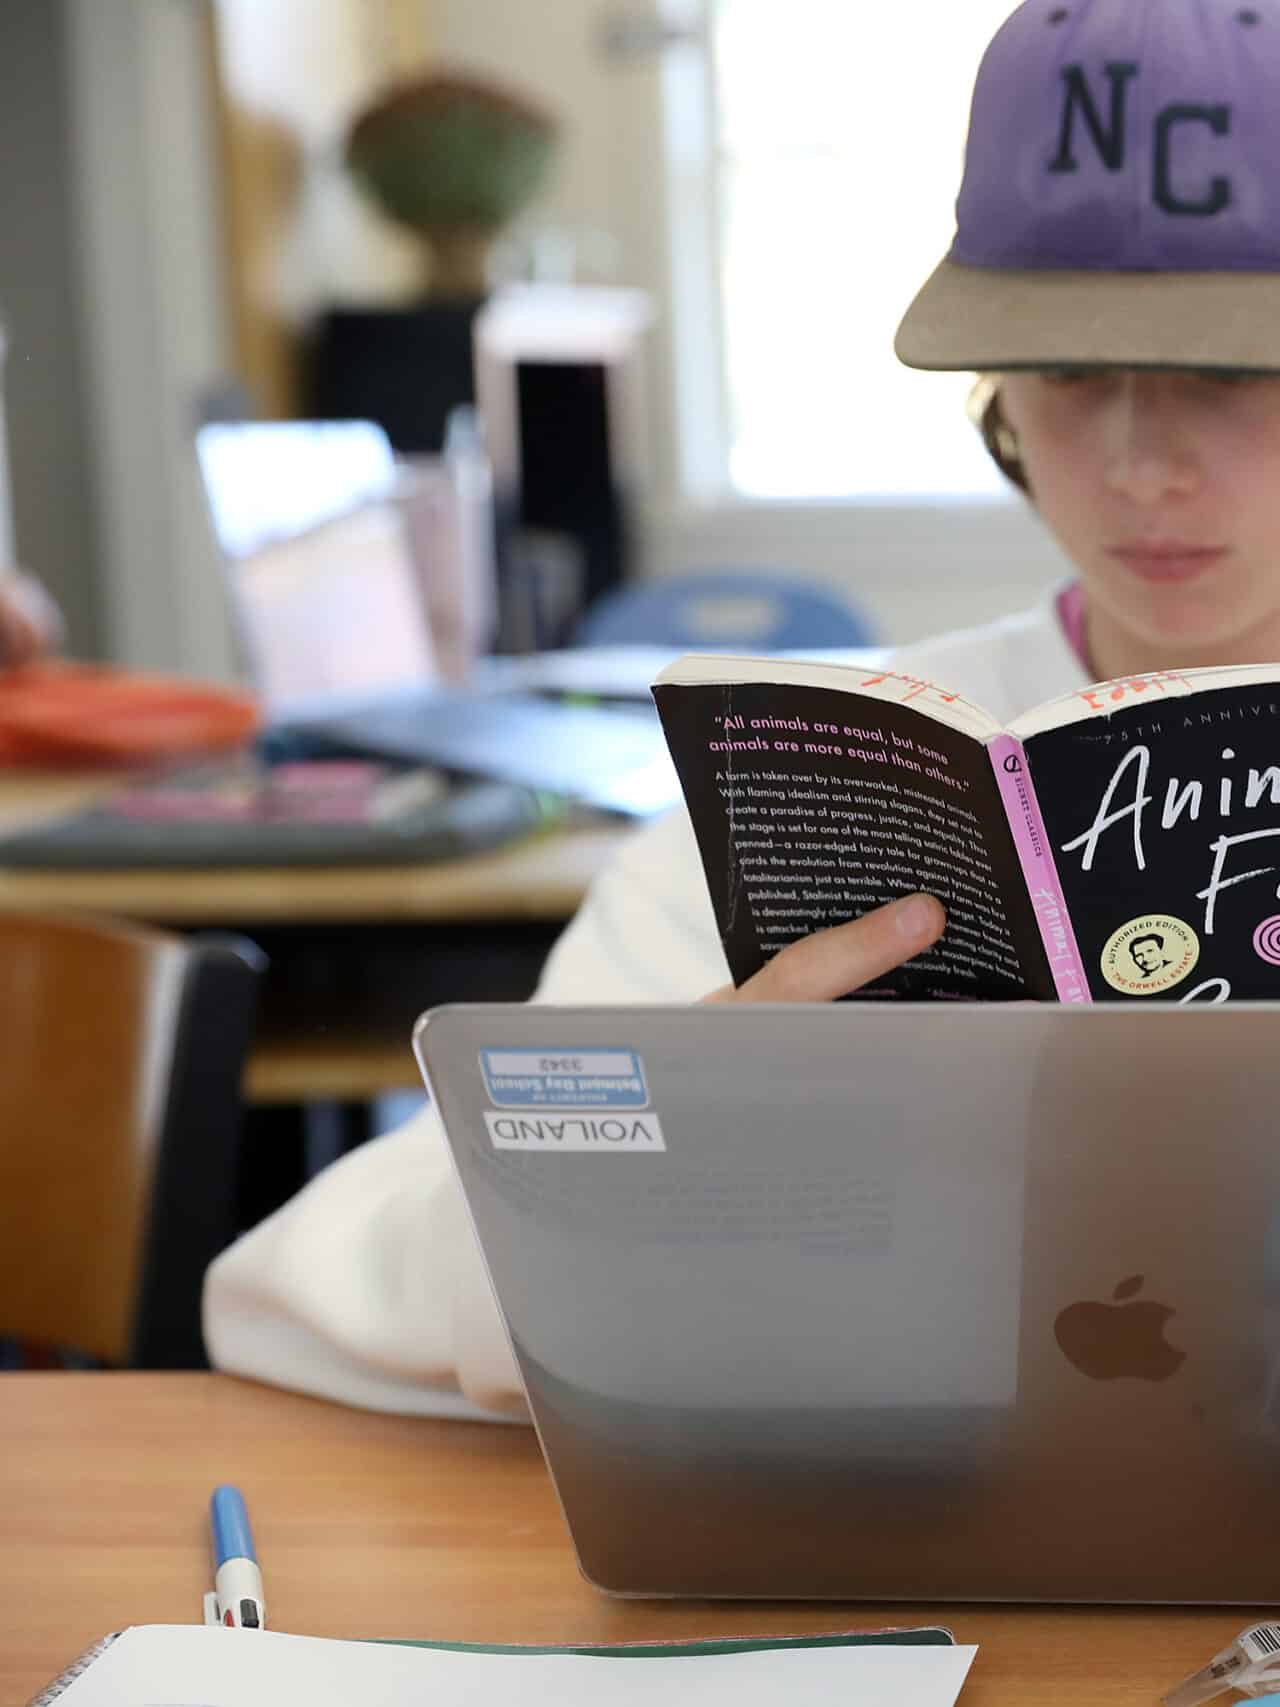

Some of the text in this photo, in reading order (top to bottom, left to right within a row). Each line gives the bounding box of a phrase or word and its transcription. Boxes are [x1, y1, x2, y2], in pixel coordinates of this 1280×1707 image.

[750, 715, 809, 731] animals
[814, 722, 839, 734] are
[843, 726, 888, 745] equal,
[891, 731, 913, 750] but
[917, 745, 949, 765] some
[1104, 722, 1161, 744] 75TH
[709, 736, 769, 752] animals
[774, 740, 800, 752] are
[804, 742, 843, 755] more
[847, 747, 888, 763] equal
[891, 752, 922, 773] than
[716, 771, 724, 780] A
[726, 770, 750, 781] farm
[752, 771, 760, 781] is
[762, 771, 790, 781] taken
[815, 772, 828, 786] by
[830, 776, 841, 785] its
[903, 788, 946, 808] mistreated
[719, 787, 745, 798] With
[747, 786, 786, 800] flaming
[788, 789, 830, 800] idealism
[832, 792, 851, 802] and
[854, 796, 888, 808] stirring
[928, 810, 945, 824] they
[974, 830, 982, 839] to
[726, 806, 758, 814] create
[770, 806, 814, 816] paradise
[818, 807, 828, 816] of
[831, 810, 876, 822] progress,
[914, 822, 931, 832] and
[970, 840, 988, 856] Thus
[748, 823, 775, 834] stage
[778, 824, 786, 832] is
[788, 824, 802, 832] set
[804, 822, 817, 833] for
[820, 826, 838, 834] one
[841, 825, 850, 836] of
[853, 826, 868, 836] the
[870, 830, 892, 840] most
[894, 832, 922, 847] telling
[740, 856, 768, 866] cords
[770, 856, 786, 866] the
[789, 856, 836, 866] evolution
[838, 857, 862, 868] from
[866, 861, 914, 874] revolution
[916, 869, 950, 883] against
[951, 879, 982, 897] tyranny
[984, 890, 993, 901] to
[795, 842, 856, 853] razor-edged
[860, 842, 884, 856] fairy
[886, 847, 905, 857] tale
[907, 848, 921, 860] for
[969, 870, 986, 884] that
[744, 874, 813, 883] totalitarianism
[814, 875, 832, 886] just
[834, 876, 846, 884] as
[886, 877, 917, 890] When
[920, 883, 950, 898] Animal
[952, 891, 974, 906] Farm
[802, 890, 842, 900] Stalinist
[844, 890, 876, 902] Russia
[752, 908, 760, 917] is
[762, 907, 826, 919] devastatingly
[828, 906, 852, 917] clear
[494, 1118, 653, 1142] VOILAND
